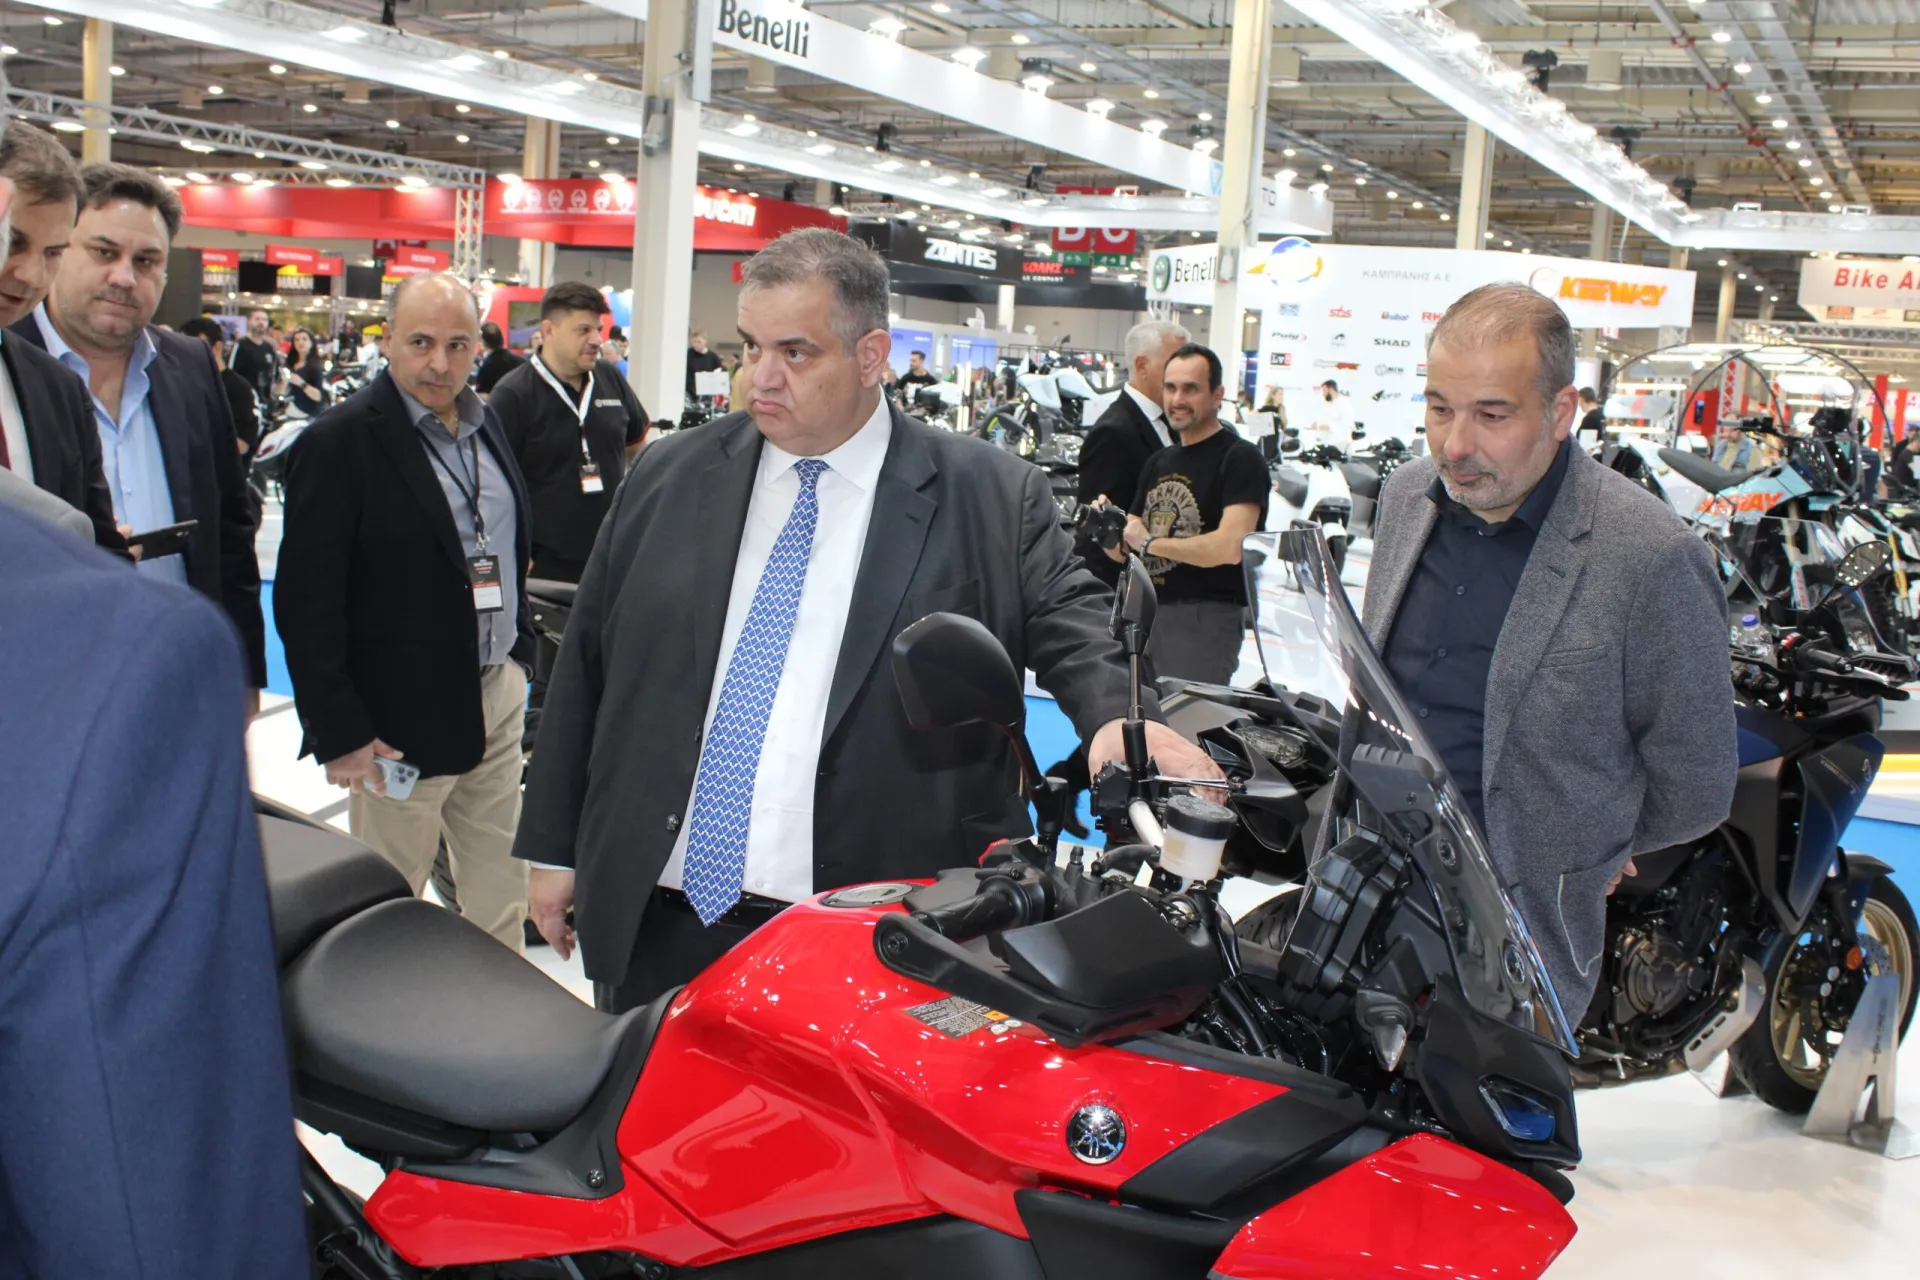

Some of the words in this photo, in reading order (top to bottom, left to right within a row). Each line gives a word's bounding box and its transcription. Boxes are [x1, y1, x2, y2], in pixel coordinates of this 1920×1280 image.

[718, 0, 809, 58] Benelli
[924, 237, 998, 271] ZONTES
[1174, 255, 1218, 283] Benell
[1834, 267, 1889, 289] Bike
[1898, 270, 1920, 291] A
[1559, 276, 1668, 307] KEEWAY
[1328, 305, 1353, 319] sbs
[1373, 337, 1411, 348] SHAD
